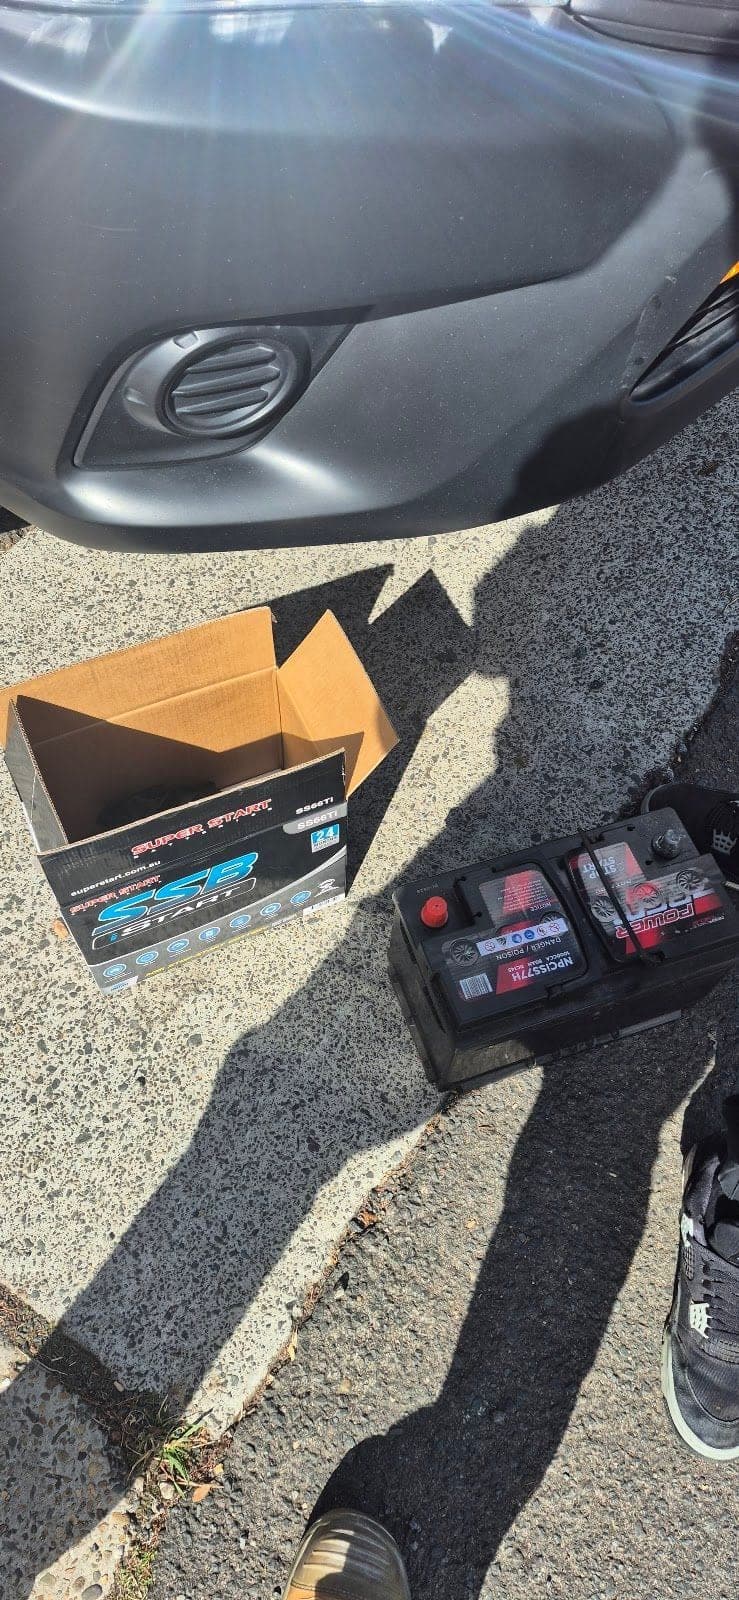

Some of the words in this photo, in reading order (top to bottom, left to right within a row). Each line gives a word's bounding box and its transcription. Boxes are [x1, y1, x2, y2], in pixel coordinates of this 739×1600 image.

[131, 824, 203, 856] SUPER
[207, 798, 272, 829] START
[315, 825, 336, 841] 24
[70, 860, 161, 897] superstart.com.au
[588, 865, 618, 879] STP
[69, 891, 118, 914] SUPER
[119, 874, 161, 896] START
[92, 852, 260, 936] SSB
[496, 948, 525, 961] POISON
[531, 937, 562, 952] DANGER
